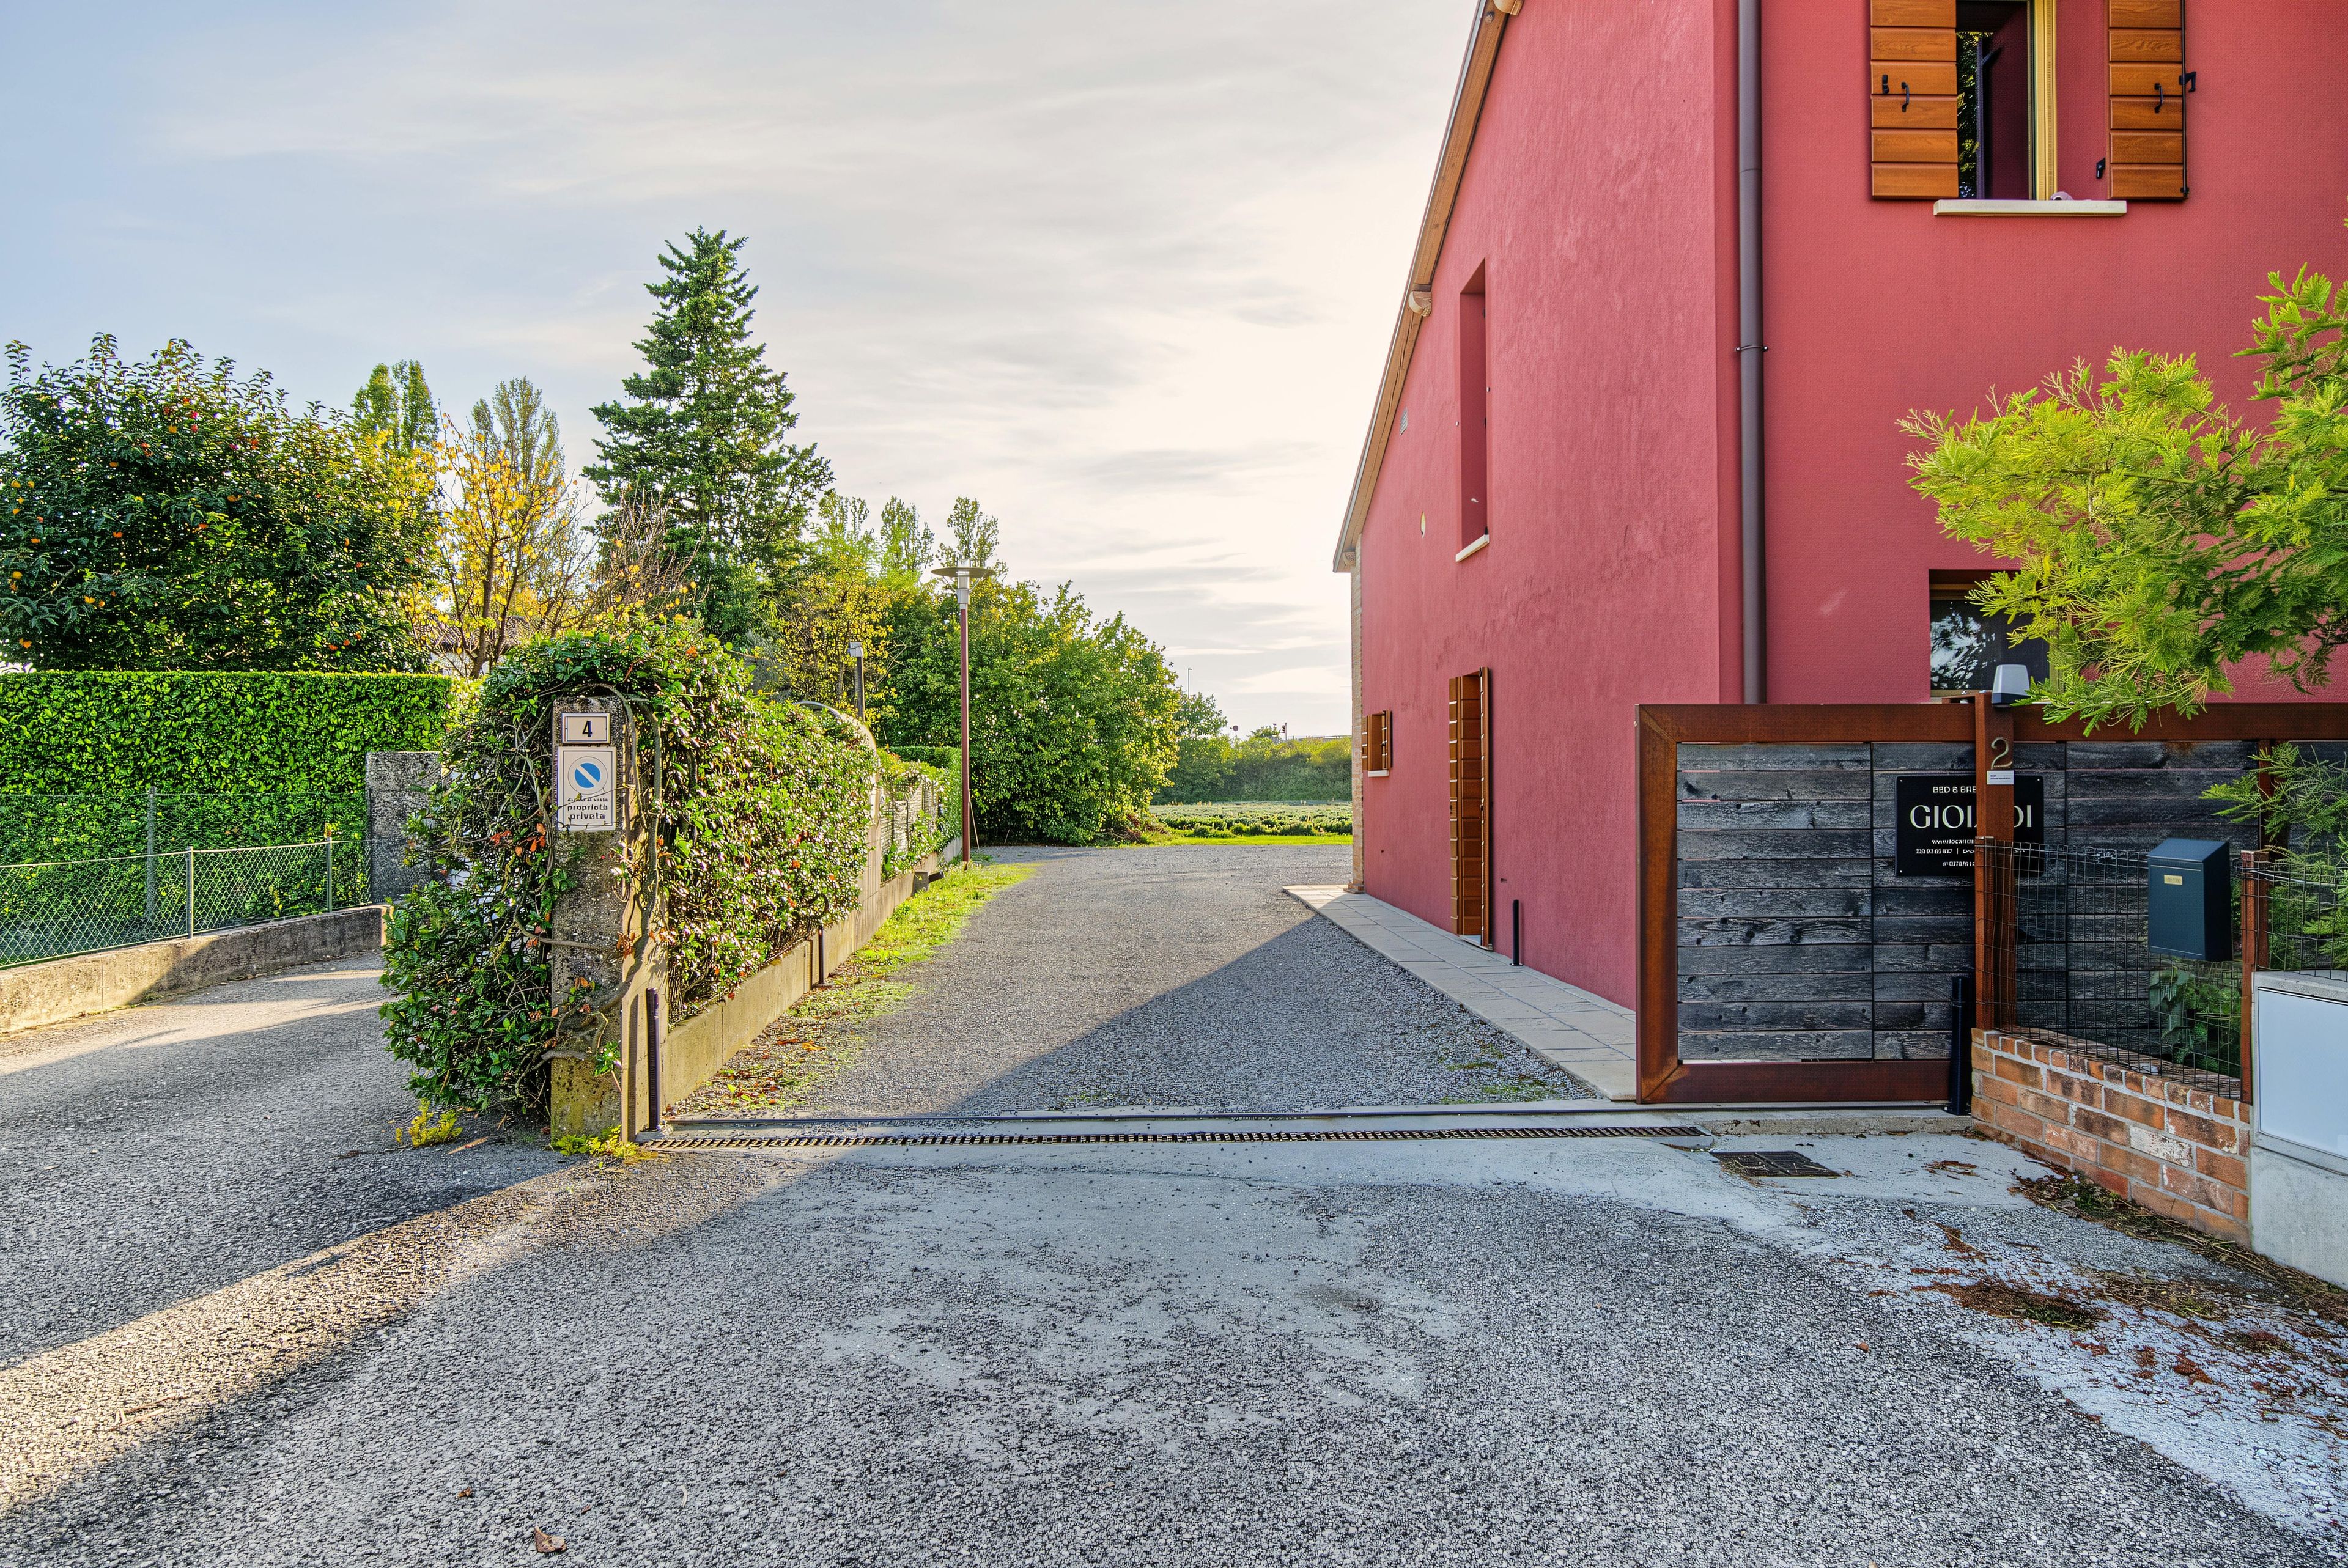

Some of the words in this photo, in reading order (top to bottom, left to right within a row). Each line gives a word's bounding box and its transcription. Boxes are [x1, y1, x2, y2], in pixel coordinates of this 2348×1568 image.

[582, 720, 593, 738] 4
[1991, 737, 2012, 770] 2
[570, 811, 605, 820] privata
